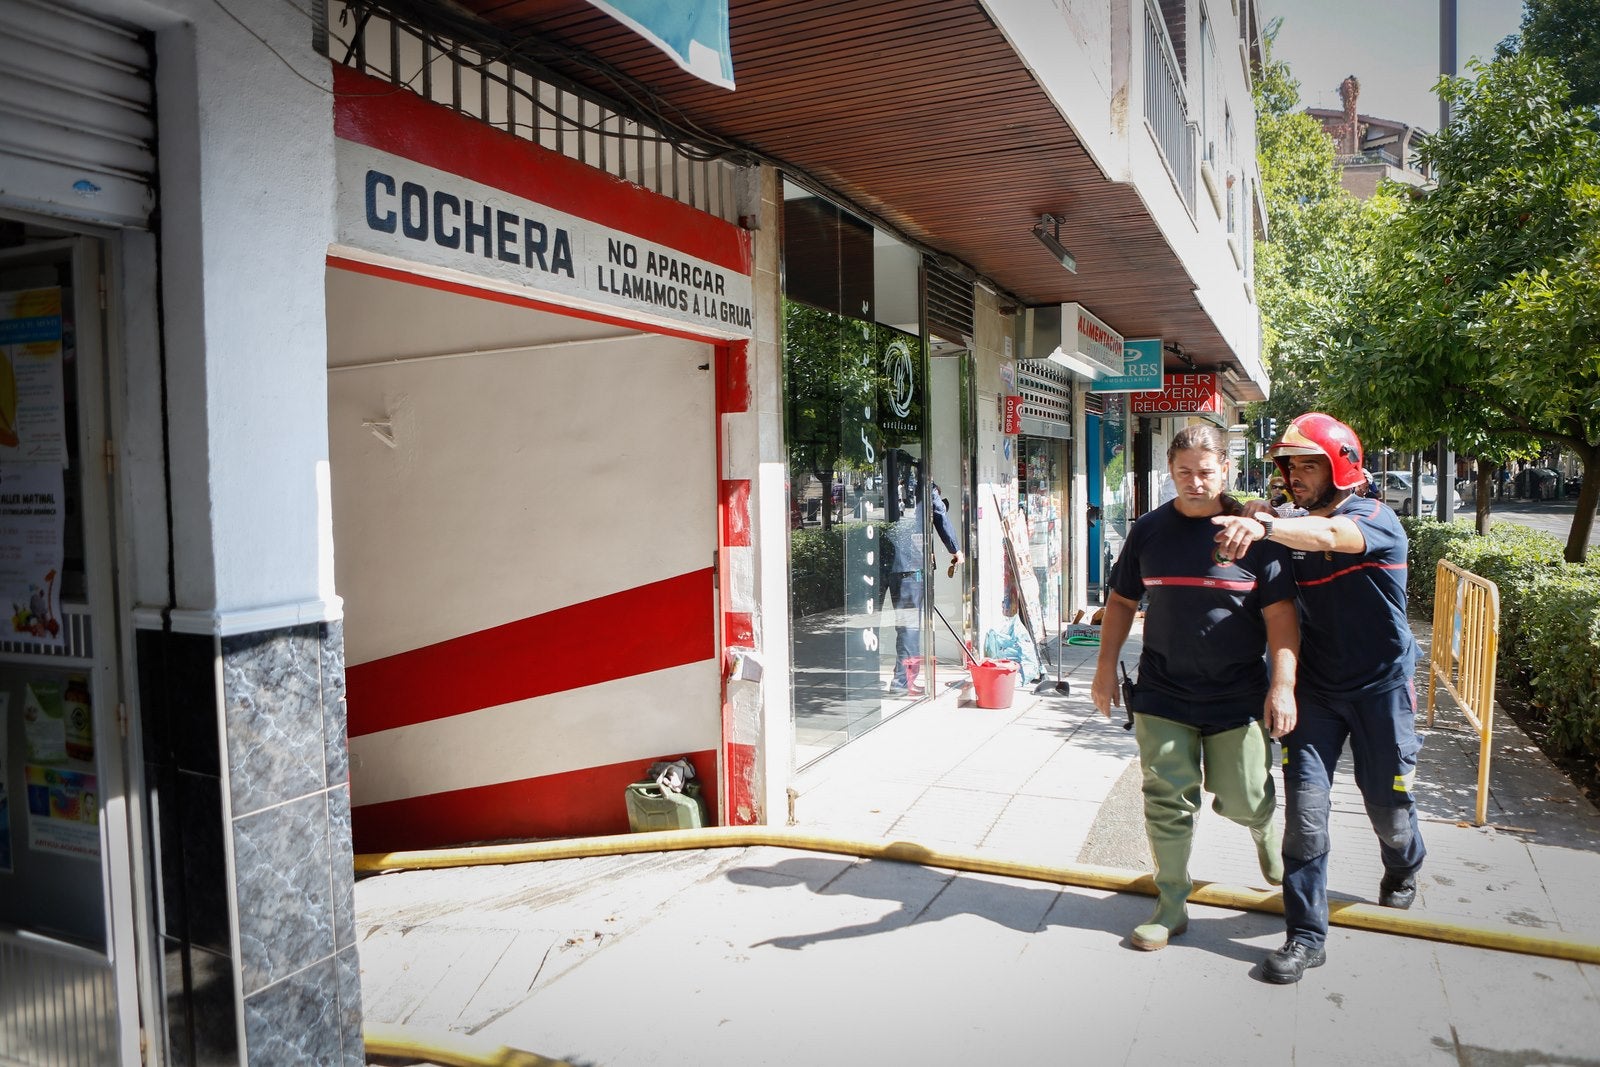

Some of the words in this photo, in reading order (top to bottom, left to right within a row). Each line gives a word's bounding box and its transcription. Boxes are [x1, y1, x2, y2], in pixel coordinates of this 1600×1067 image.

[365, 169, 575, 278] COCHERA
[607, 237, 638, 270] NO
[647, 250, 726, 296] APARCAR
[597, 264, 689, 312] LLAMAMOS
[692, 298, 701, 316] A
[703, 295, 718, 320] LA
[719, 300, 753, 331] GRUA
[1077, 315, 1123, 357] ALIMENTACIÓN
[1124, 363, 1158, 377] RES
[1135, 387, 1211, 400] JOYERIA
[1006, 399, 1015, 423] FRIGO
[1134, 400, 1212, 413] RELOJERIA
[882, 420, 918, 431] estilistas
[22, 492, 56, 505] MATINAL
